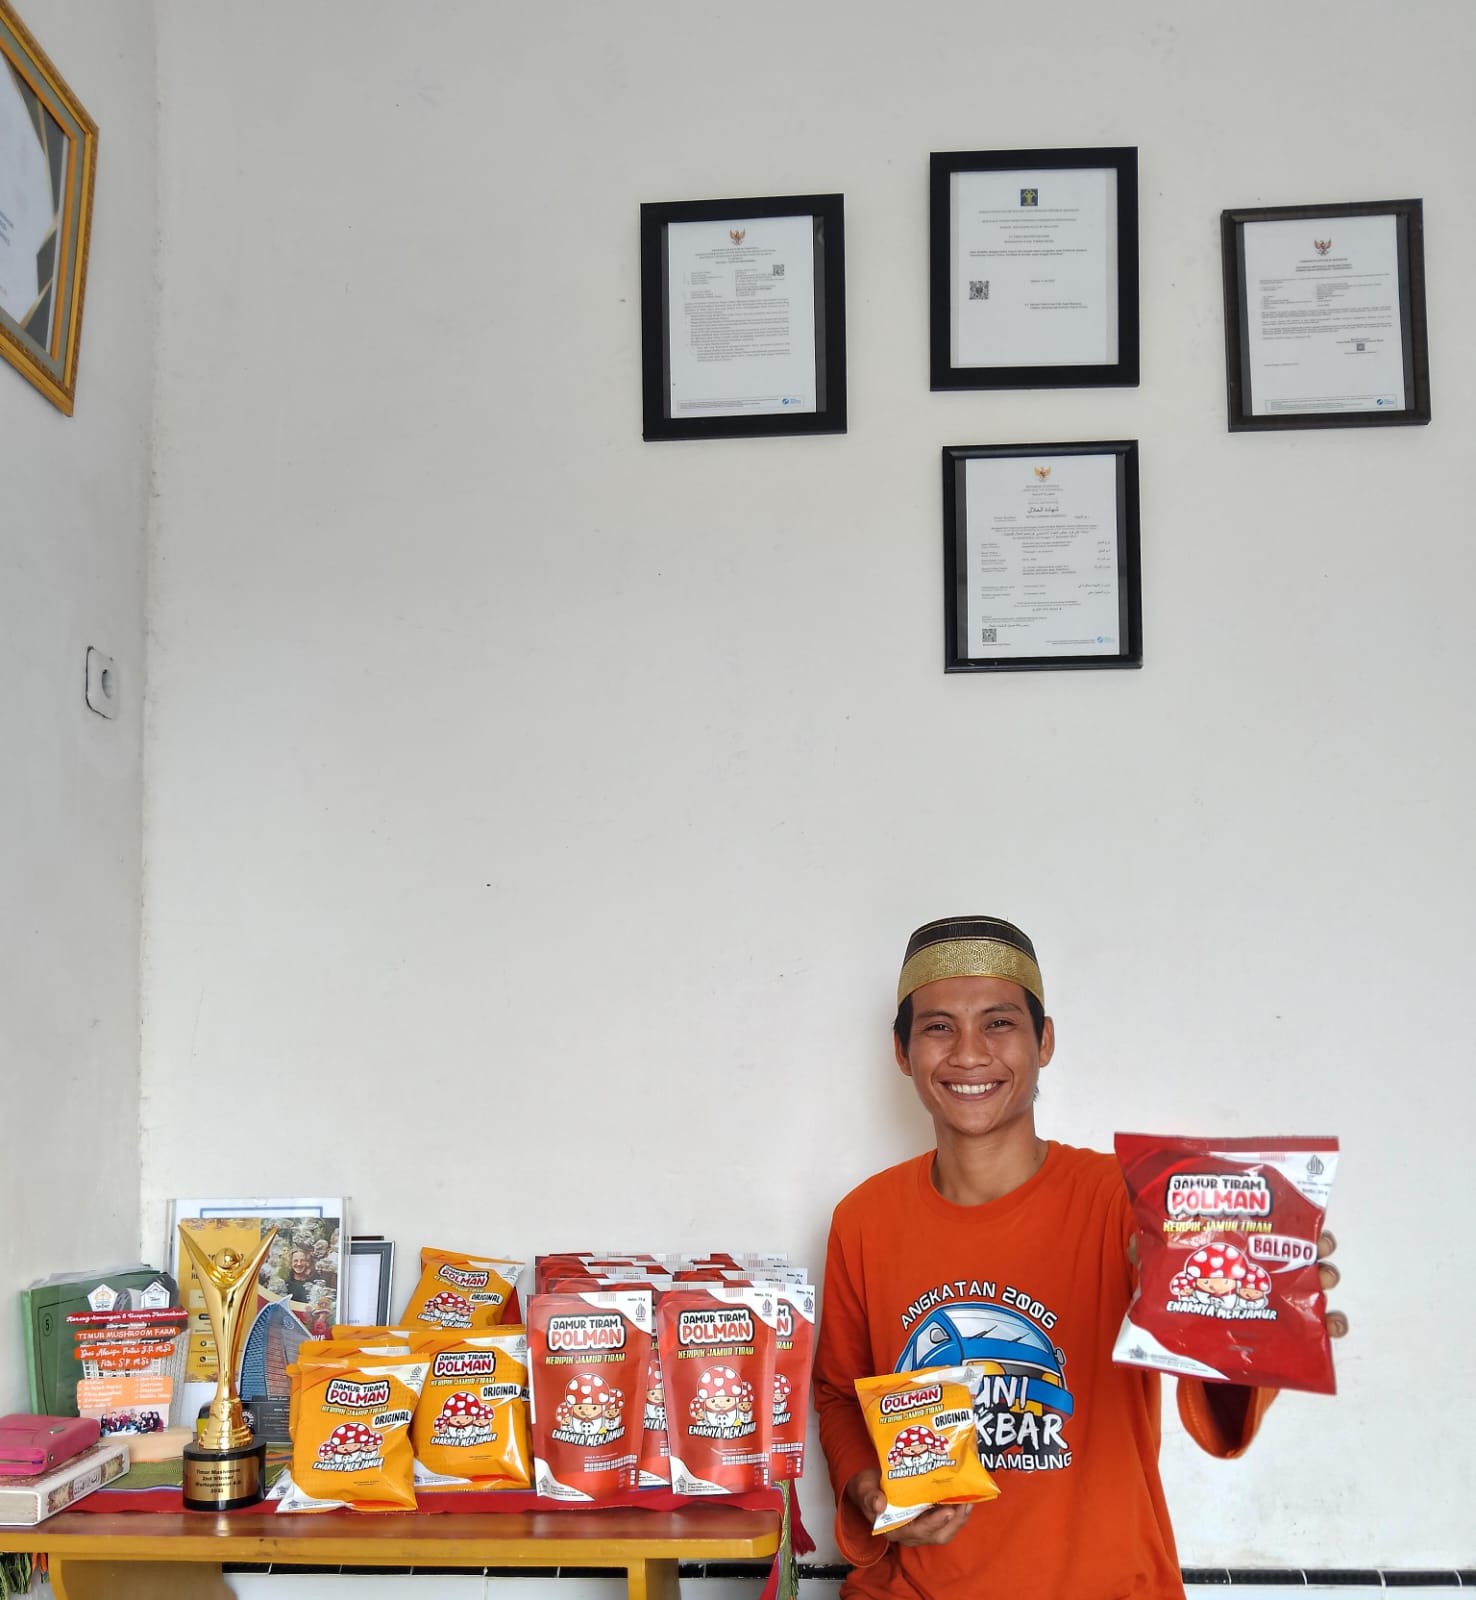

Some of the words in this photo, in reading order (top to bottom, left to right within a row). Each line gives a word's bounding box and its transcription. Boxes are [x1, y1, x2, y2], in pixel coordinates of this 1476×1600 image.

[1173, 1178, 1218, 1190] JAMUR
[1222, 1179, 1262, 1190] TIRAM
[1172, 1190, 1266, 1210] POLMAN
[1163, 1220, 1201, 1232] KERIPIK
[1203, 1220, 1239, 1232] JAMUR
[1241, 1221, 1273, 1233] TIRAM
[1253, 1239, 1314, 1260] BALADO
[442, 1269, 486, 1286] POLMAN
[471, 1293, 501, 1303] ORIGINAL
[900, 1280, 996, 1330] ANGKATAN
[1166, 1300, 1215, 1318] ENAKNYA
[1216, 1307, 1277, 1320] MENJAMUR
[552, 1320, 587, 1330] JAMUR
[589, 1318, 618, 1329] TIRAM
[683, 1314, 716, 1324] JAMUR
[717, 1313, 747, 1322] TIRAM
[106, 1329, 153, 1338] MUSHROOM
[154, 1328, 176, 1336] FARM
[551, 1328, 622, 1347] POLMAN
[682, 1322, 750, 1340] POLMAN
[776, 1341, 793, 1350] RAM
[545, 1356, 574, 1365] KERIPIK
[575, 1355, 603, 1364] JAMUR
[603, 1353, 625, 1362] TIRAM
[677, 1349, 705, 1360] KERIPIK
[707, 1347, 733, 1358] JAMUR
[734, 1346, 754, 1356] TIRAM
[437, 1360, 492, 1373] POLMAN
[333, 1382, 361, 1392] JAMUR
[363, 1383, 386, 1392] TIRAM
[482, 1385, 518, 1398] ORIGINAL
[330, 1390, 386, 1404] POLMAN
[884, 1388, 938, 1409] POLMAN
[374, 1411, 411, 1426] ORIGINAL
[935, 1410, 971, 1427] ORIGINAL
[551, 1429, 586, 1446] ENAKNYA
[586, 1426, 625, 1447] MENJAMUR
[688, 1424, 722, 1439] ENAKNYA
[722, 1421, 757, 1440] MENJAMUR
[975, 1411, 1069, 1450] KBAR
